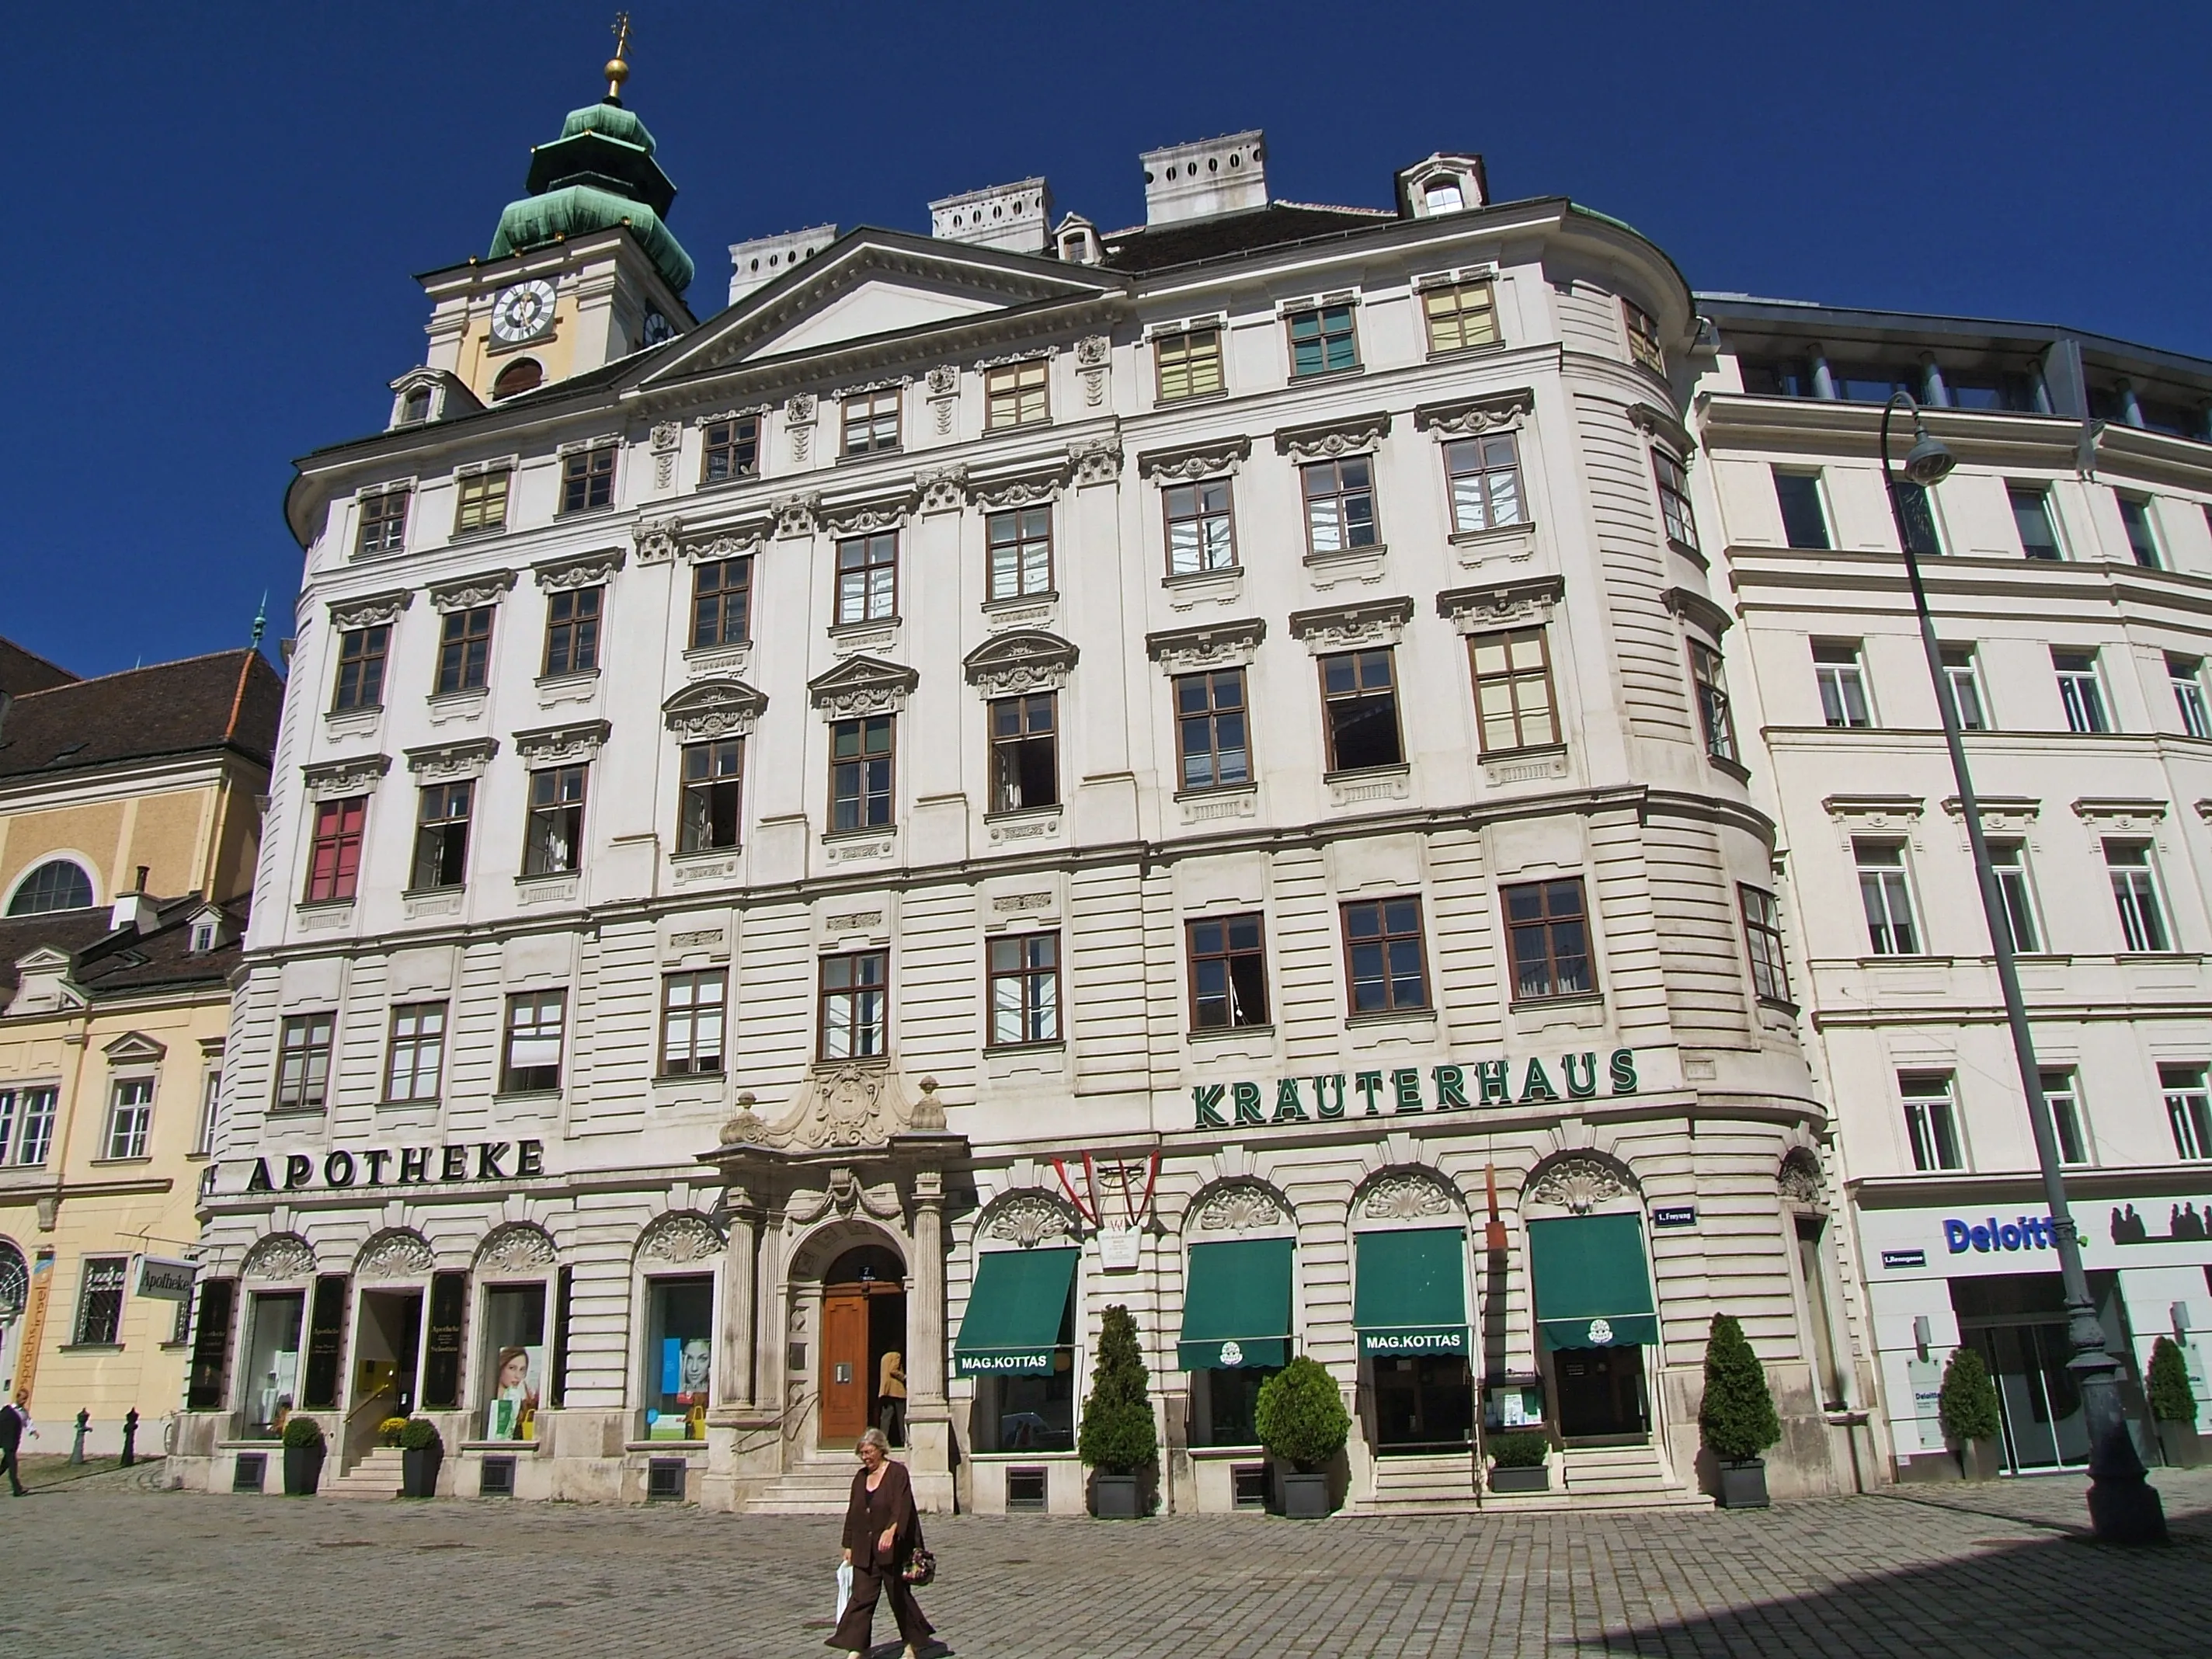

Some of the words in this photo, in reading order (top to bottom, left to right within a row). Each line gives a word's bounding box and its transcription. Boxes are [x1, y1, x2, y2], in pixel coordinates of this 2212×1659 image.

[1191, 1047, 1639, 1129] KRÄUTERHAUS
[246, 1139, 545, 1191] APOTHEKE
[1942, 1216, 2059, 1254] Deloitt
[141, 1270, 190, 1292] Apotheke
[19, 1285, 48, 1389] sprächsinsel
[1365, 1334, 1461, 1349] MAG.KOTTAS
[962, 1355, 1047, 1369] MAG.KOTTAS
